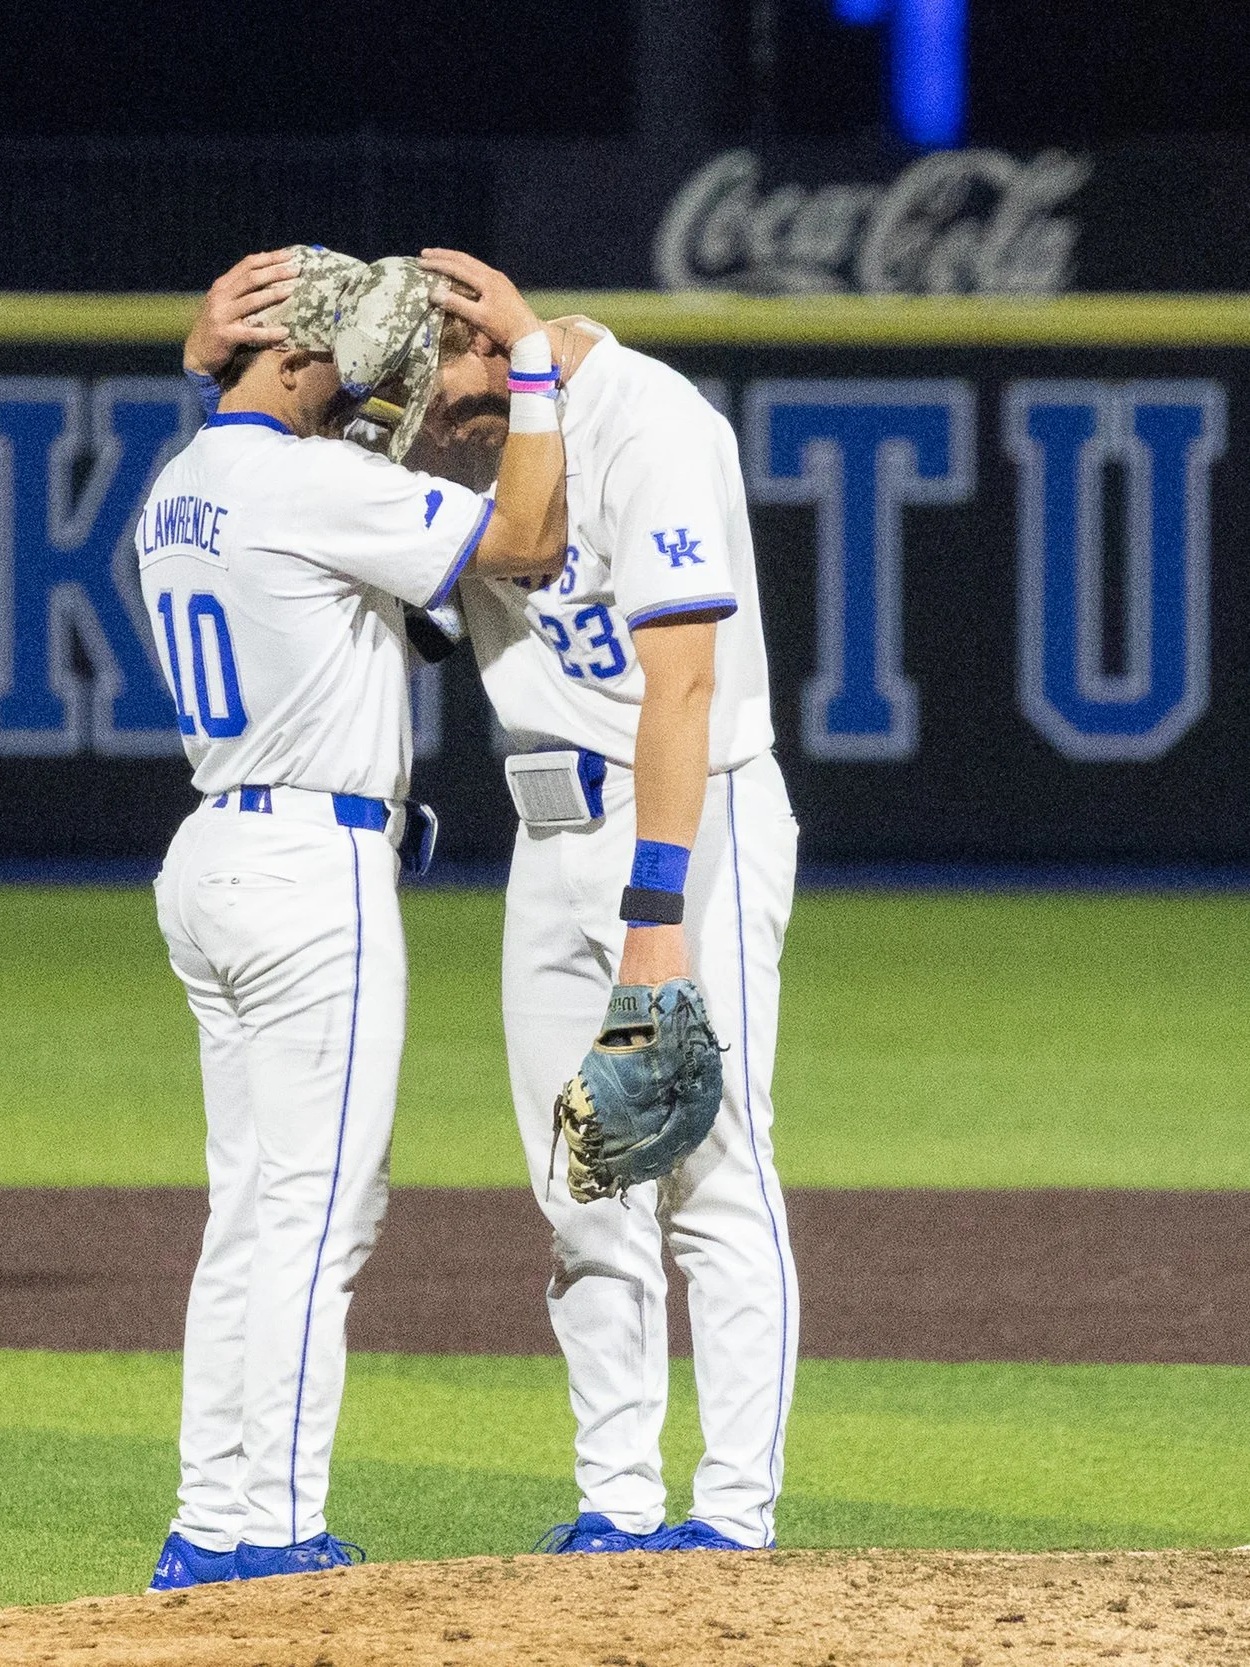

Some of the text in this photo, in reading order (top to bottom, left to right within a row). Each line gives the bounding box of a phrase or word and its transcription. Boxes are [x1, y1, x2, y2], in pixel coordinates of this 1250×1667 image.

[143, 495, 229, 557] LAWRENCE
[651, 528, 706, 568] UK
[156, 589, 250, 740] 10
[538, 602, 628, 680] 23
